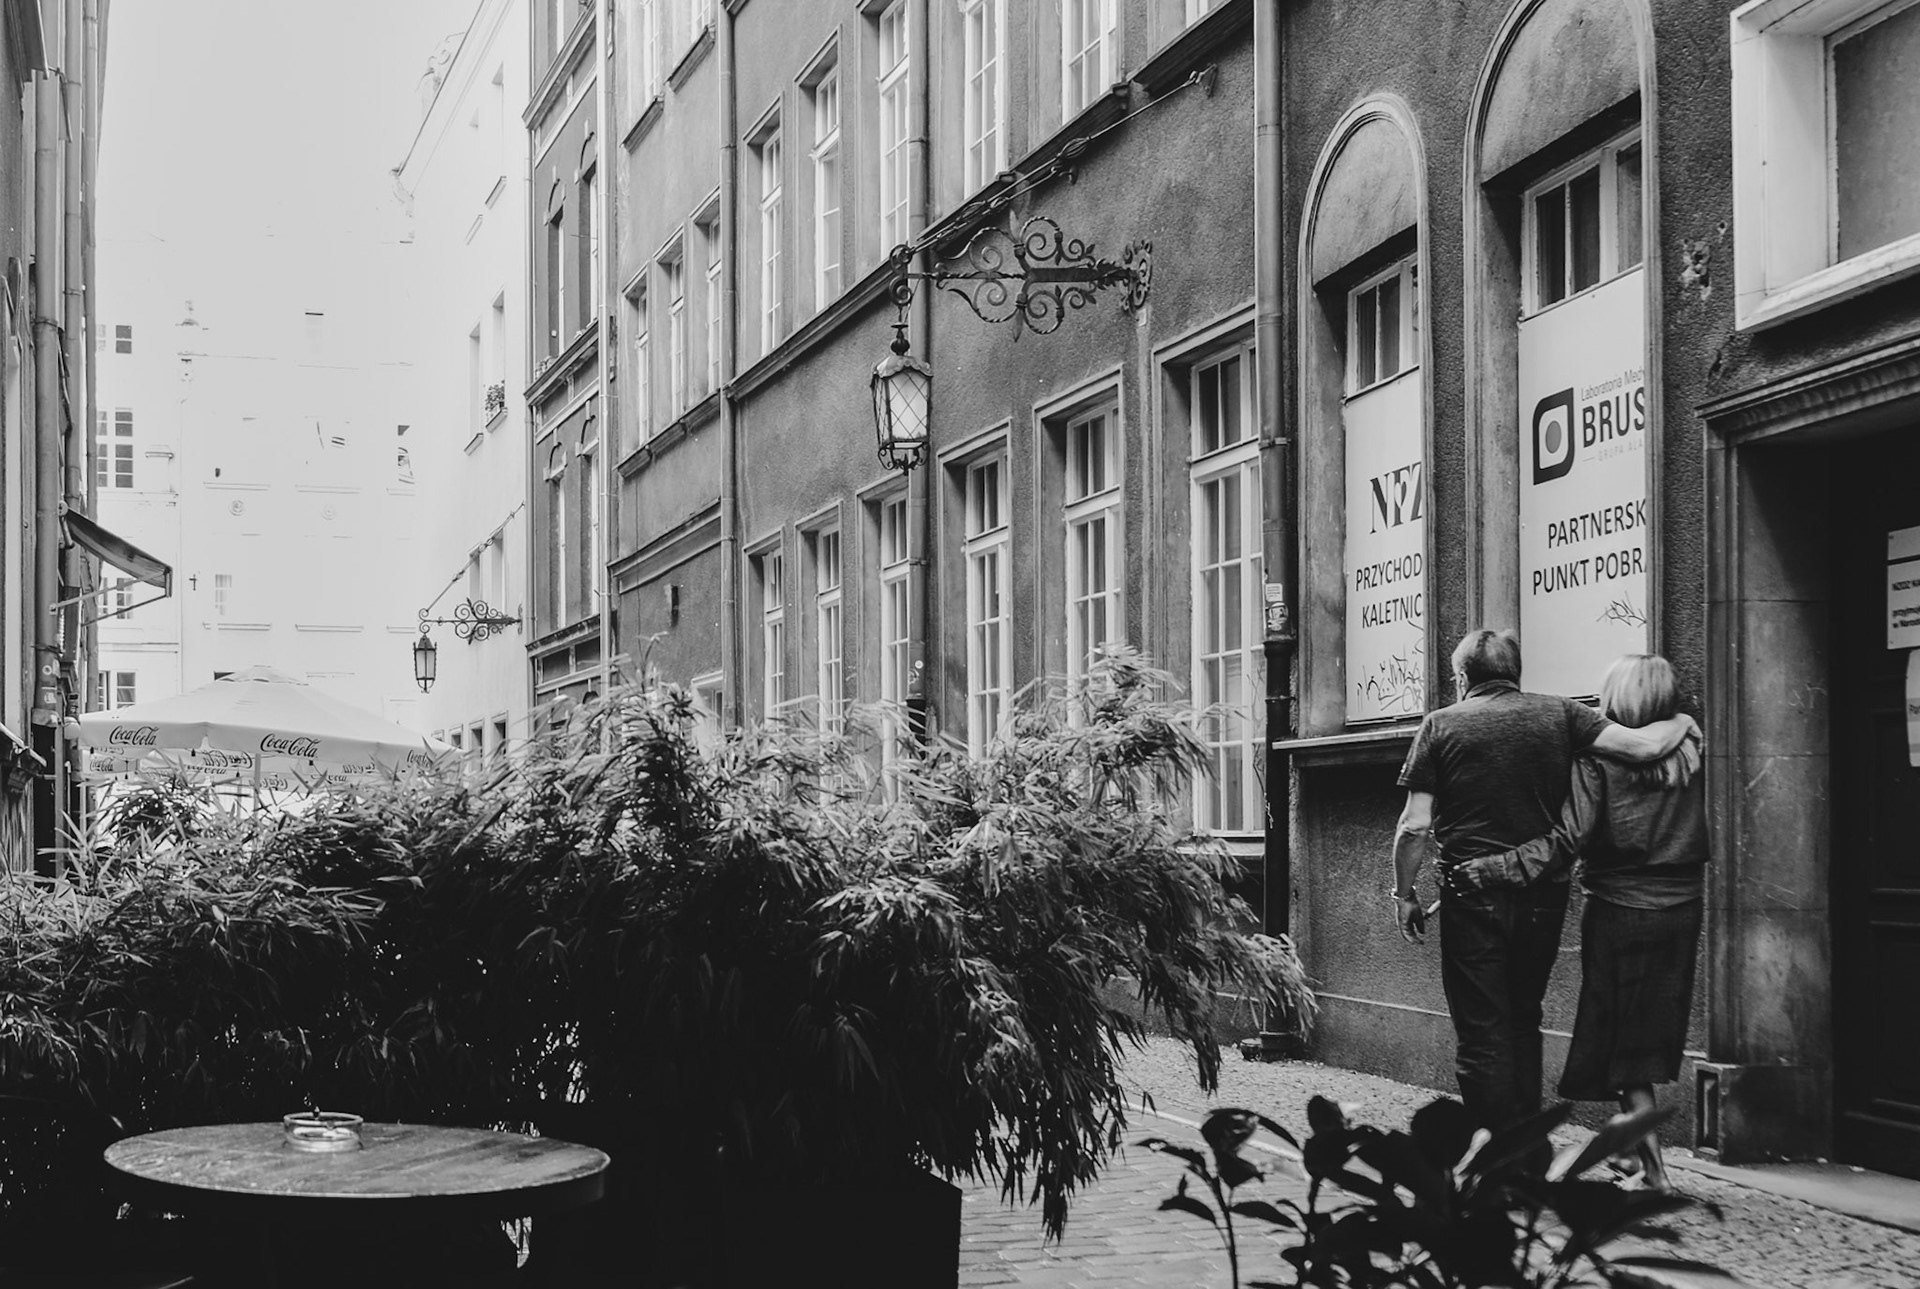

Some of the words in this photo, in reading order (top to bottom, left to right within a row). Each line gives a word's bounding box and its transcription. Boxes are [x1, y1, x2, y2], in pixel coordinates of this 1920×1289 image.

[1624, 365, 1645, 386] Med
[1582, 387, 1645, 448] BRUS
[1548, 498, 1646, 549] PARTNERSK
[1356, 552, 1422, 592] PRZYCHOD
[1533, 558, 1589, 595] PUNKT
[1595, 547, 1646, 583] POBR
[109, 725, 160, 746] Coca-Cola
[259, 733, 322, 758] Coca-Cola
